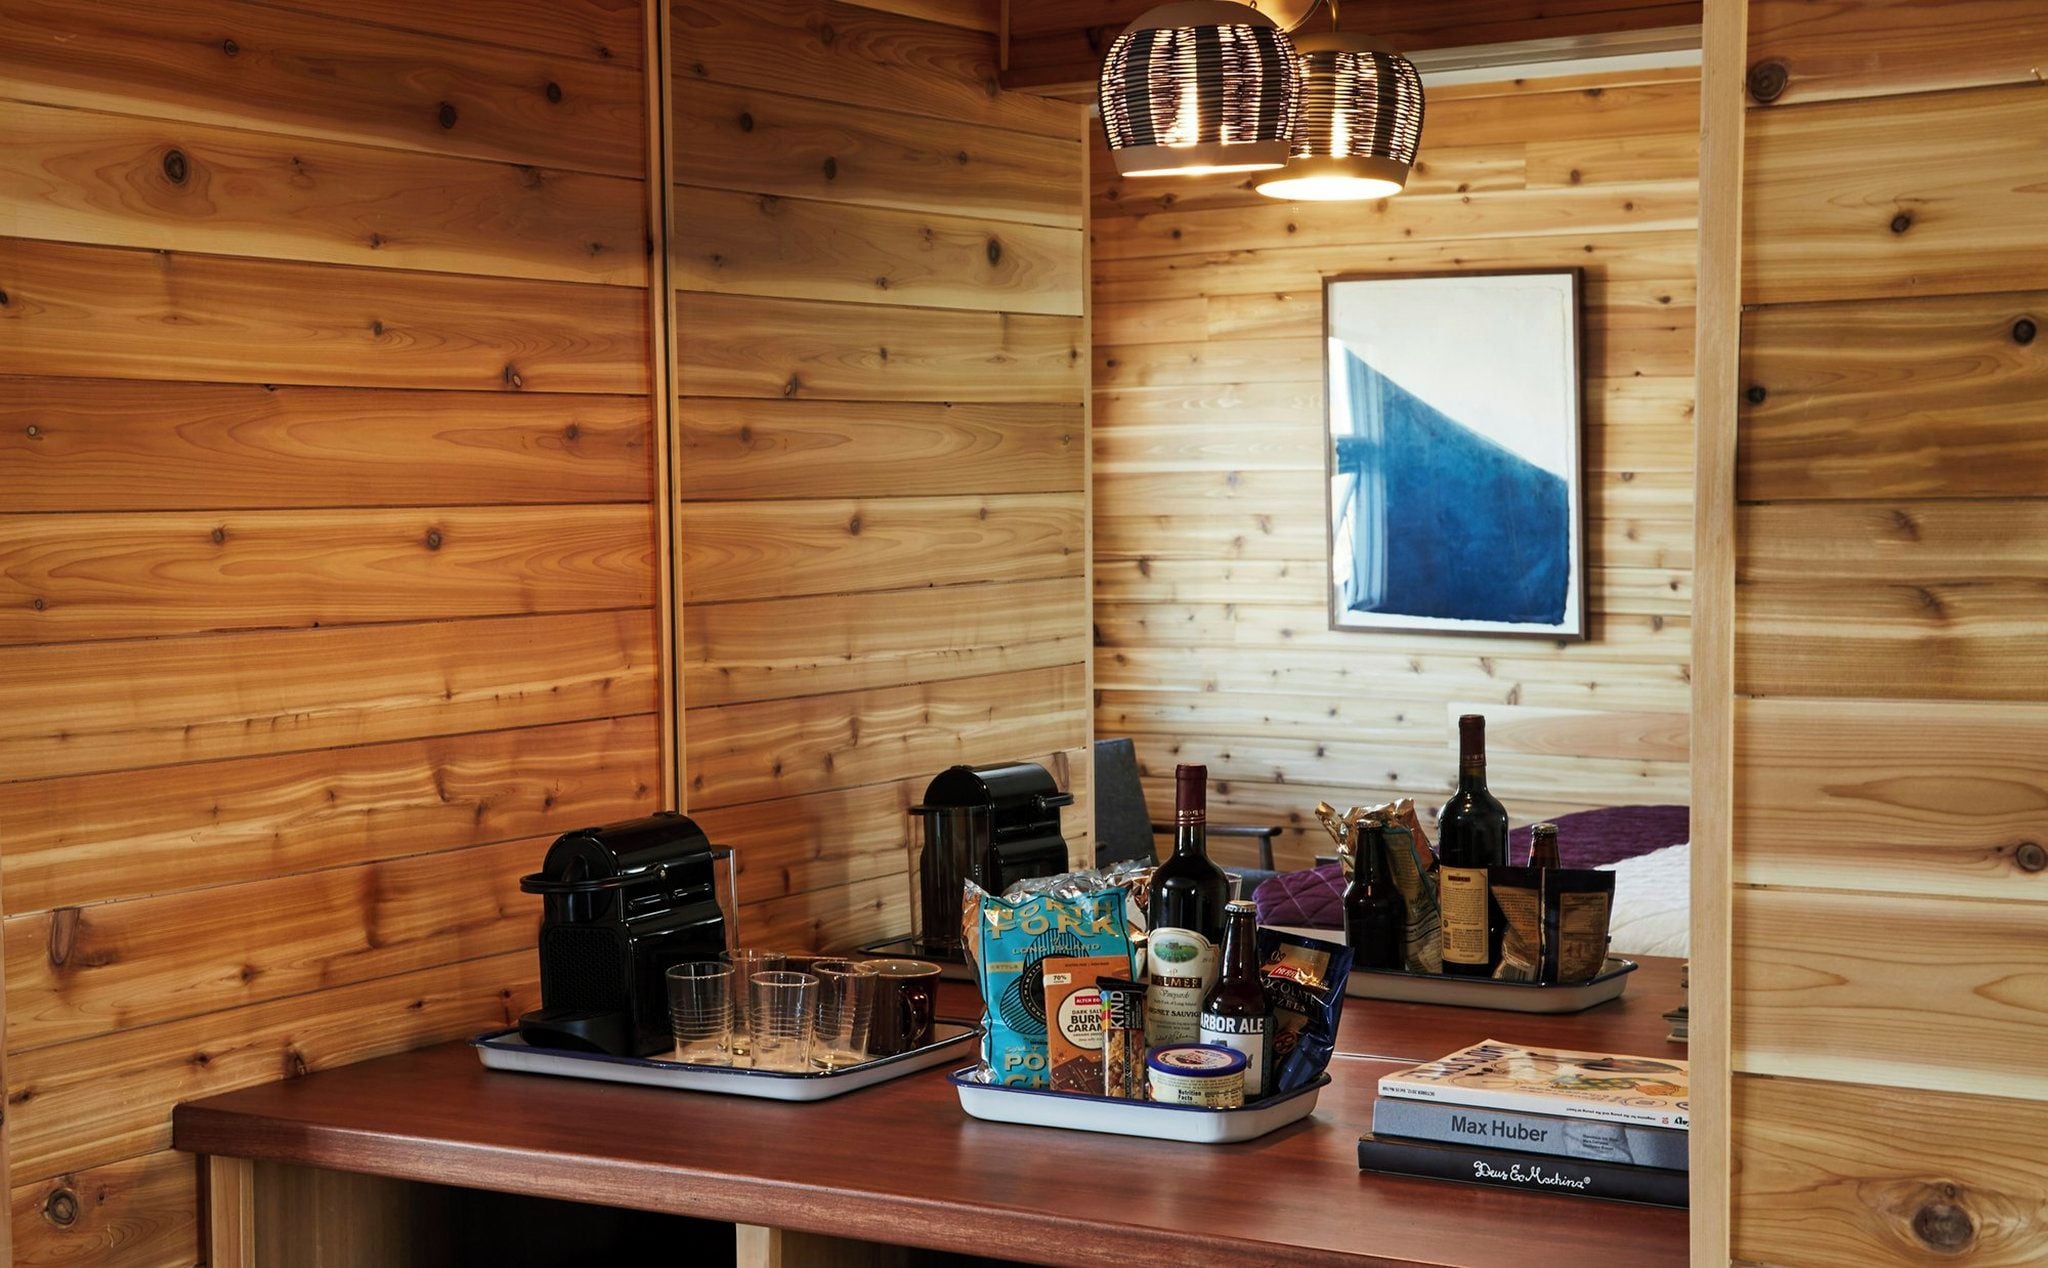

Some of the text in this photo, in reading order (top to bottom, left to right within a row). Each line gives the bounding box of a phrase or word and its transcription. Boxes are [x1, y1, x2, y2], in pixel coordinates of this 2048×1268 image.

[987, 913, 1118, 940] FORK
[1154, 976, 1200, 988] LMER
[1110, 990, 1124, 1030] KIND
[1239, 1018, 1264, 1033] ALE
[1451, 1115, 1548, 1142] Max Huber
[1473, 1160, 1508, 1181] Deus
